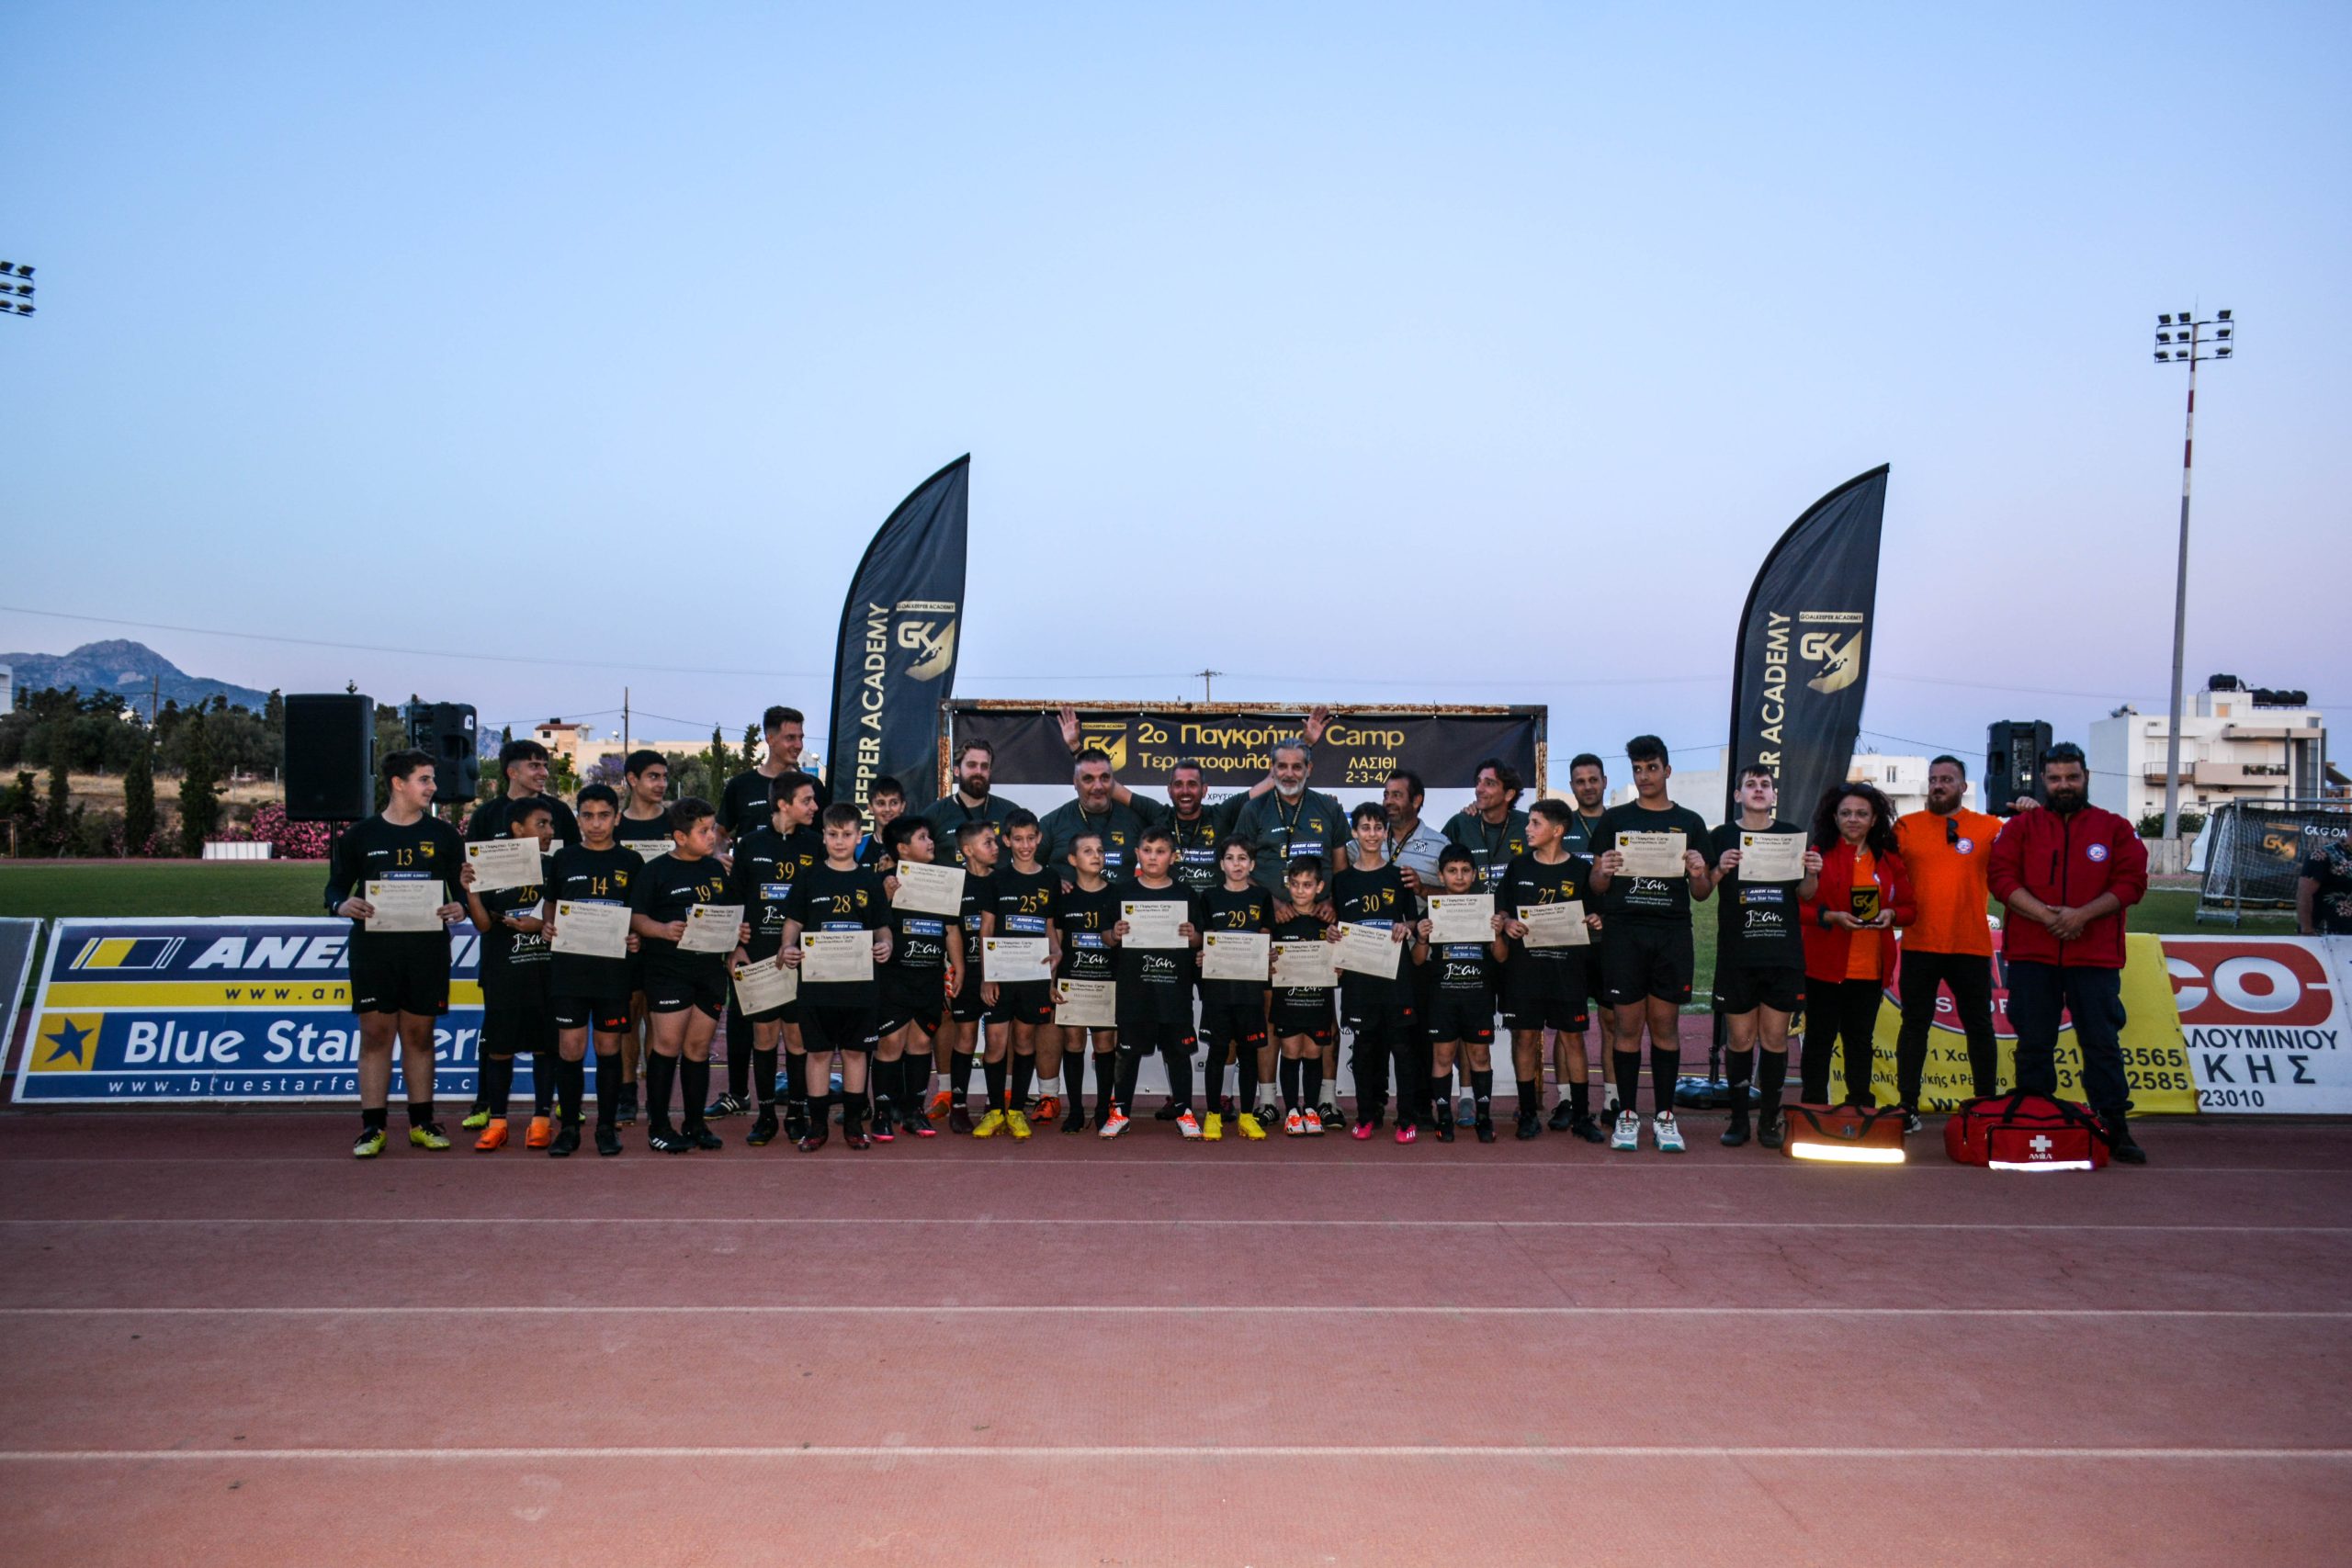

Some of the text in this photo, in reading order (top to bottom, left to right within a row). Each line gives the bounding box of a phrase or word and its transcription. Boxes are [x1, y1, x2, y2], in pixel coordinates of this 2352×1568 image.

[861, 603, 889, 731] ACADEMY
[1760, 611, 1791, 745] ACADEMY
[1326, 725, 1405, 750] Camp
[1349, 757, 1396, 770] ΛΑΣΙΘΙ
[1345, 771, 1392, 783] 2-3-4/
[1207, 793, 1236, 801] ΧΡΥΣΟ
[396, 848, 413, 865] 13
[775, 862, 795, 880] 39
[518, 886, 538, 903] 26
[591, 876, 608, 896] 14
[695, 885, 711, 902] 19
[832, 895, 851, 913] 28
[1020, 895, 1037, 913] 25
[1363, 895, 1380, 913] 30
[1538, 887, 1556, 905] 27
[1084, 911, 1098, 929] 31
[1227, 910, 1246, 929] 29
[225, 987, 345, 1000] www.an
[2165, 956, 2301, 1013] CO
[123, 1021, 245, 1063] Blue
[2120, 1048, 2183, 1066] 8565
[2202, 1054, 2316, 1085] ΚΗΣ
[2127, 1071, 2188, 1090] 2585
